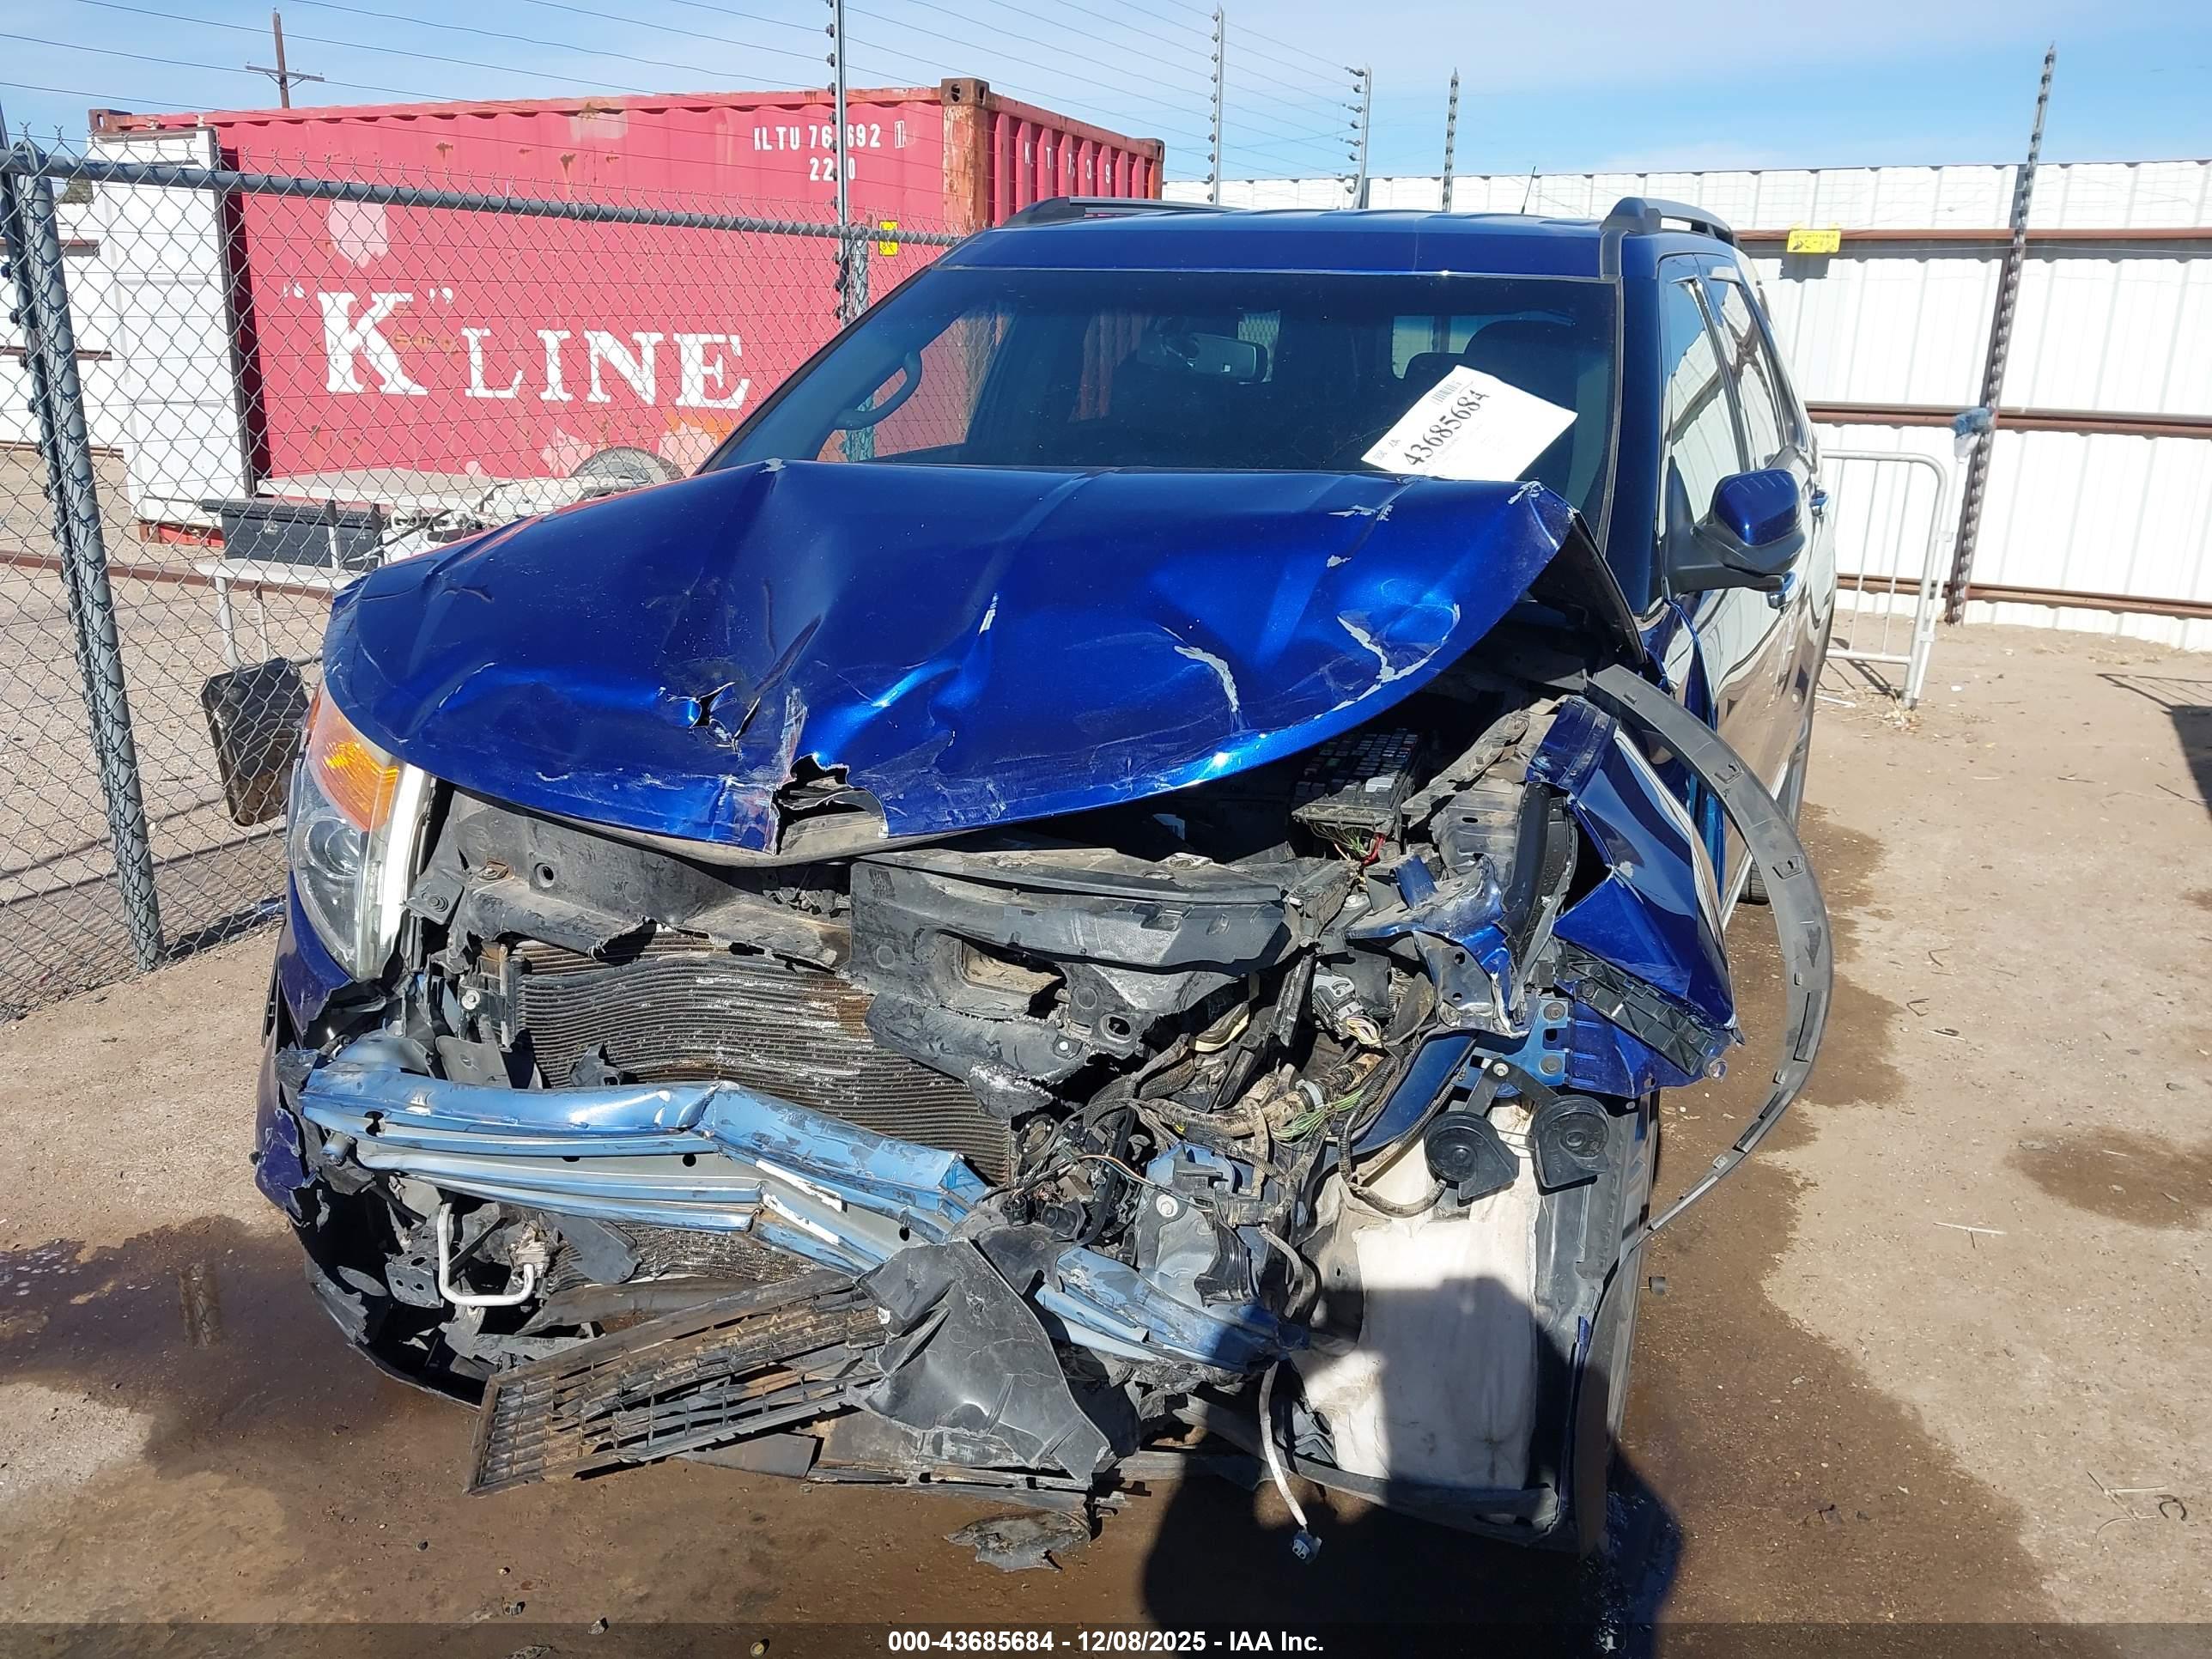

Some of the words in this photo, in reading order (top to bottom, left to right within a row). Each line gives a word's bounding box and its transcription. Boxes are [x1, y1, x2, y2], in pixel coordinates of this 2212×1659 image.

[754, 126, 799, 150] KLTU
[808, 123, 881, 149] 76692
[809, 157, 855, 181] 220
[461, 328, 750, 410] LINE
[1404, 390, 1491, 465] 43685684
